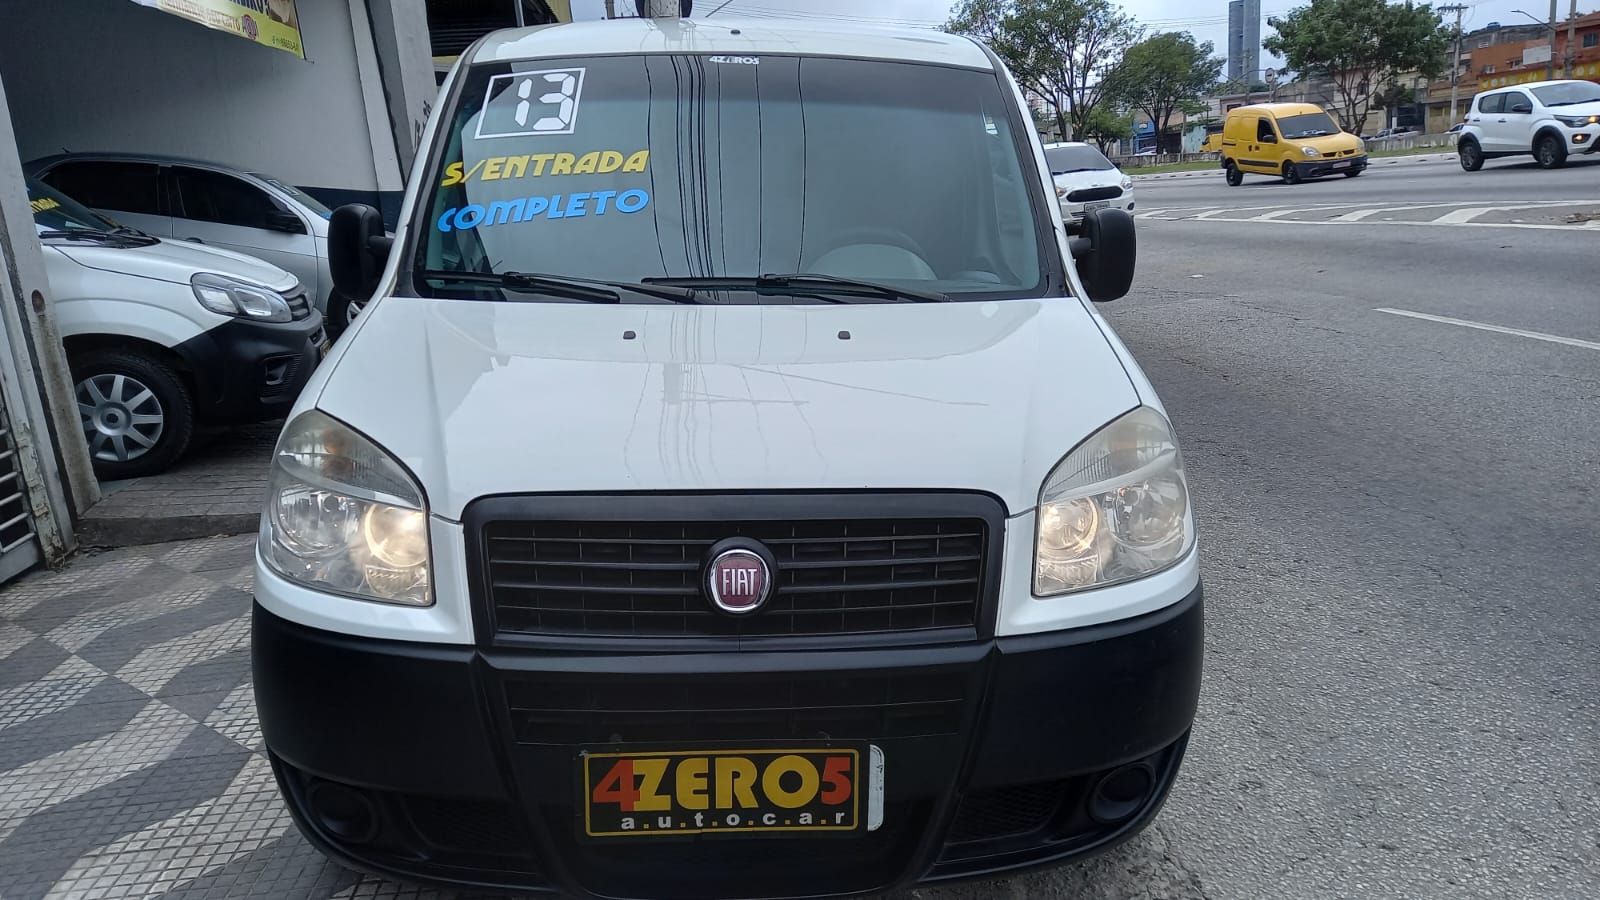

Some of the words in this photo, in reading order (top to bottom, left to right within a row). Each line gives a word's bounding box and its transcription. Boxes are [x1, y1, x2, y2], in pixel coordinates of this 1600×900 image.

[514, 72, 576, 131] 13
[441, 149, 650, 188] S/ENTRADA
[437, 188, 649, 232] COMPLETO
[722, 568, 757, 596] FIAT
[592, 753, 852, 812] 4ZERO5
